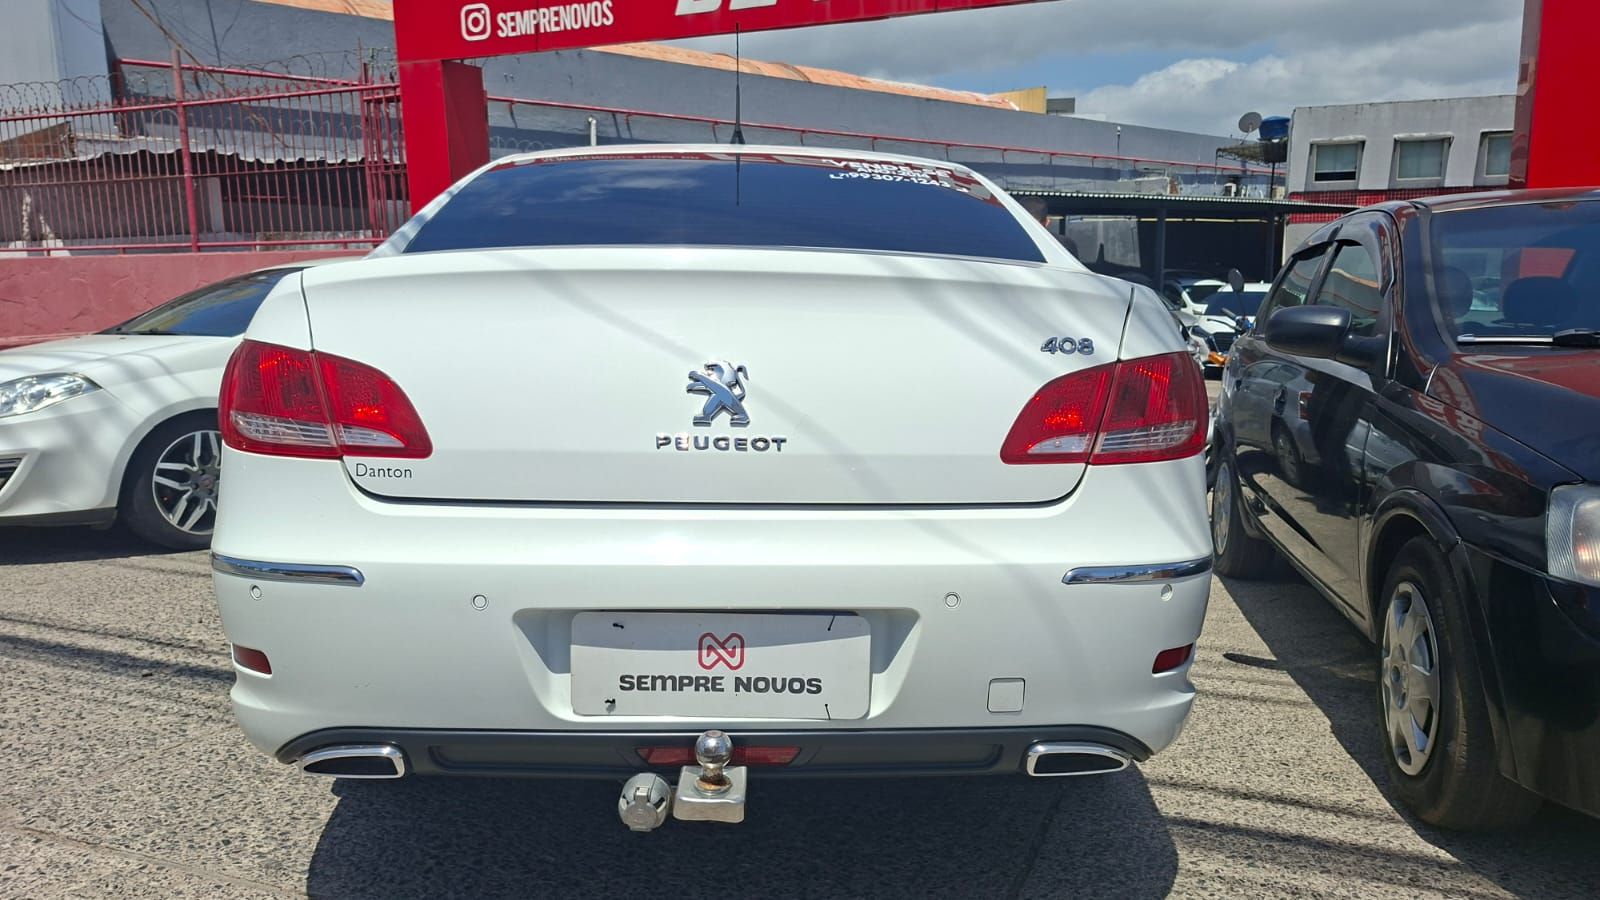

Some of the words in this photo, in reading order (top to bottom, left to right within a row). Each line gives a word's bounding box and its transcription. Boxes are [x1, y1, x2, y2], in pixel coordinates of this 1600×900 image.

[497, 0, 614, 38] SEMPRENOVOS
[1040, 336, 1094, 355] 408
[655, 434, 787, 452] PEUGEOT
[355, 462, 412, 478] Danton
[619, 674, 725, 693] SEMPRE
[734, 676, 823, 694] NOVOS
